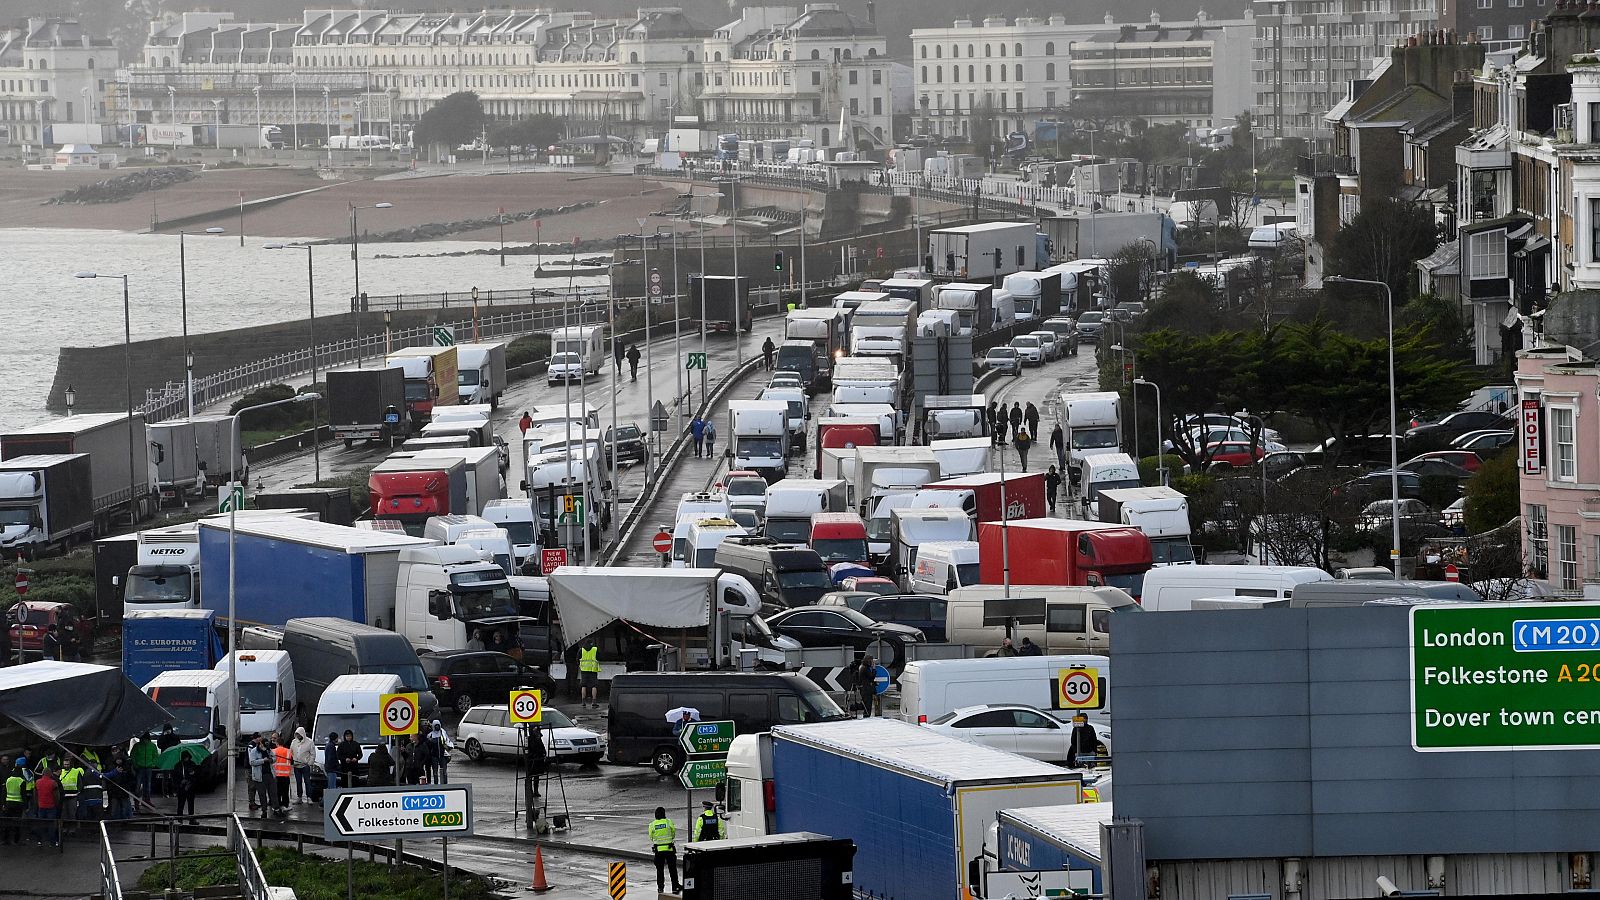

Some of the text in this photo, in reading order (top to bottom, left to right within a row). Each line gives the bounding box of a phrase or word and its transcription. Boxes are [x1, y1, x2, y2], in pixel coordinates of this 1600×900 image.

[1525, 411, 1538, 471] HOTEL
[1423, 628, 1504, 647] London
[1424, 665, 1549, 685] Folkestone
[1067, 681, 1091, 695] 30
[516, 700, 535, 712] 30
[387, 706, 411, 722] 30
[1425, 708, 1491, 727] Dover
[1499, 707, 1555, 726] town
[698, 725, 717, 733] (M2)
[697, 736, 732, 745] Canterbury
[357, 800, 398, 810] London
[358, 817, 420, 828] Folkestone
